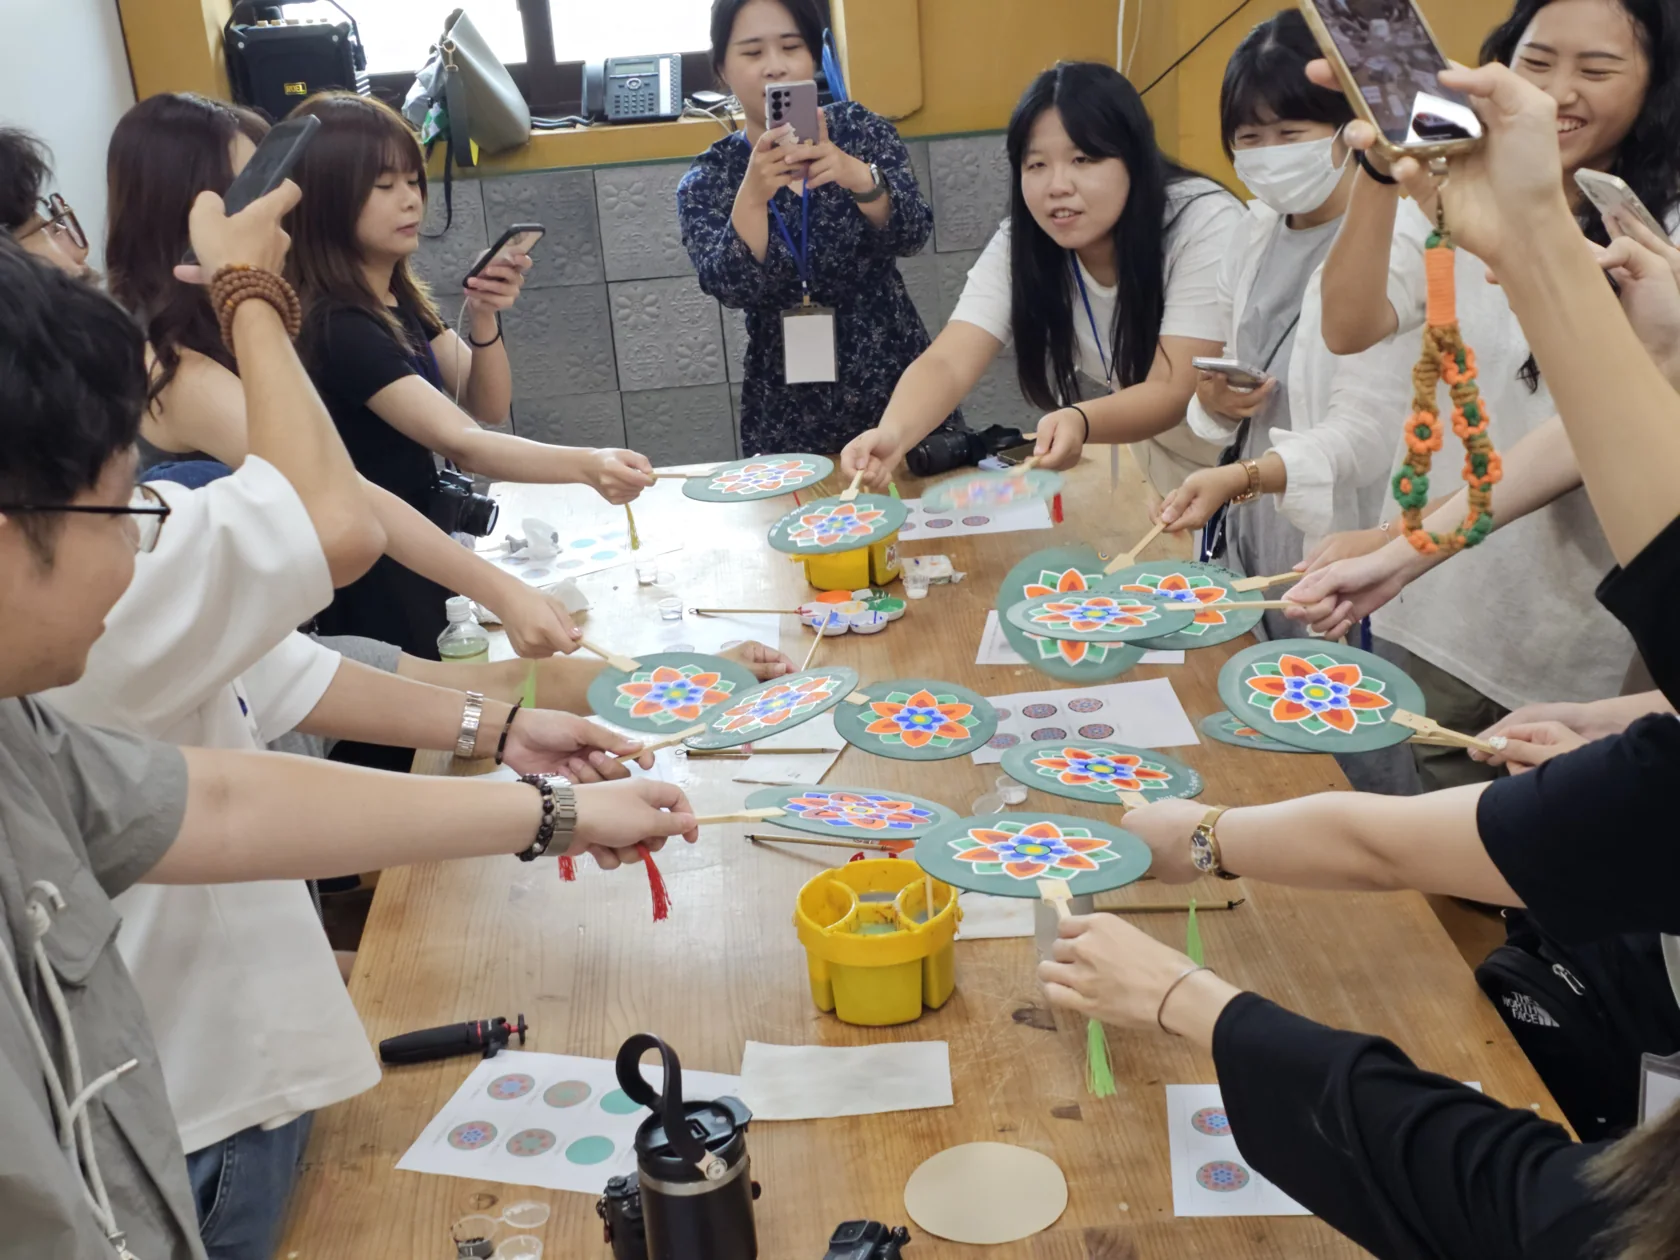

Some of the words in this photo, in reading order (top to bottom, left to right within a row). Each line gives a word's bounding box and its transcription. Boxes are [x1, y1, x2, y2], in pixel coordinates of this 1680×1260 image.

[1502, 995, 1538, 1015] NORTH
[1511, 991, 1532, 1005] THE
[1512, 1008, 1539, 1024] FACE
